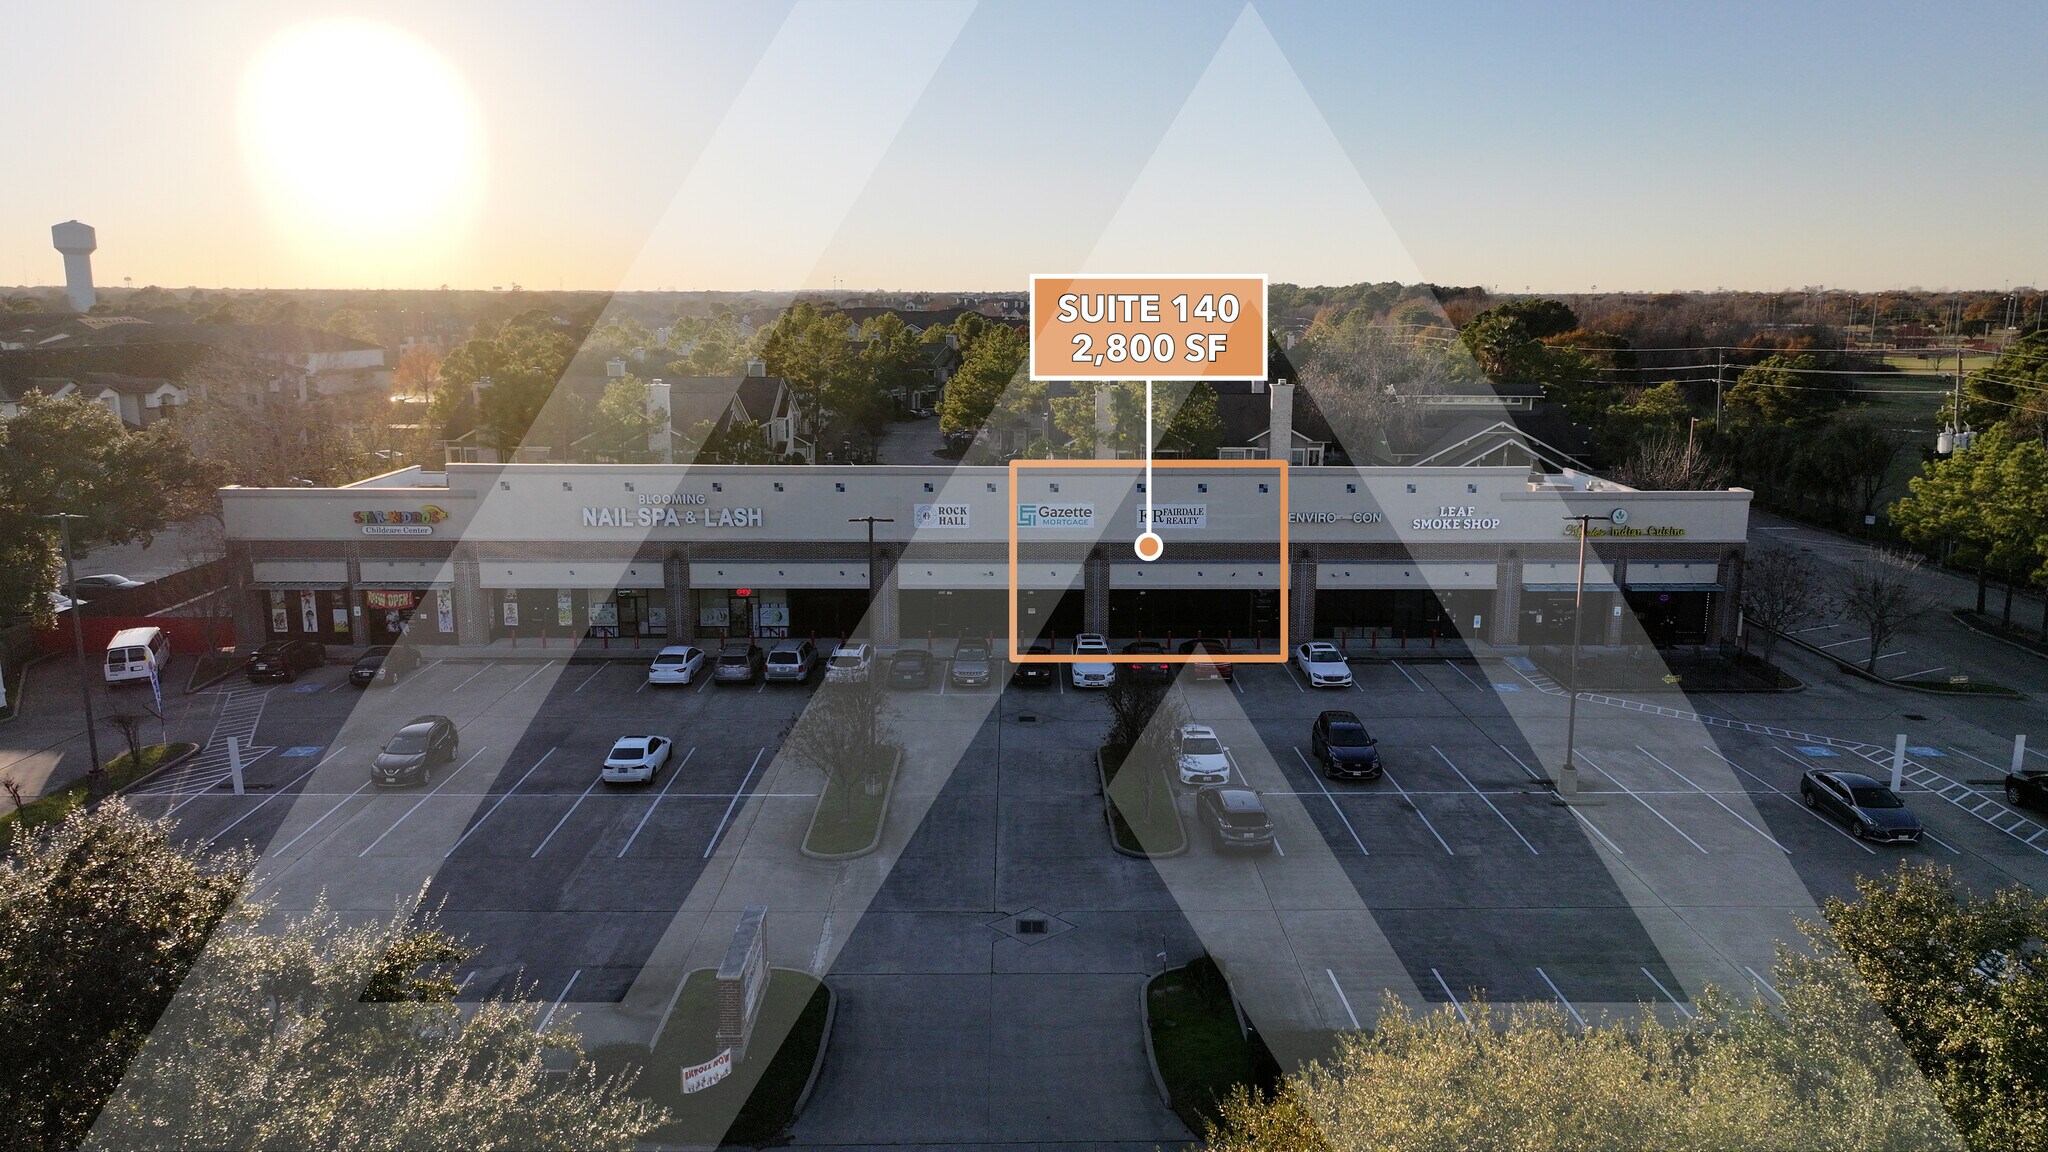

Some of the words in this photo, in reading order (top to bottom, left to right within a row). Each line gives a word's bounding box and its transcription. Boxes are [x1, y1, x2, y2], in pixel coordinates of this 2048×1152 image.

[638, 494, 706, 505] BLOOMING
[938, 506, 967, 516] ROCK
[1038, 506, 1092, 518] Gazette
[1163, 508, 1204, 516] FAIRDALE
[1439, 506, 1475, 517] LEAF
[582, 507, 634, 527] NAIL
[637, 507, 680, 527] SPA
[685, 511, 697, 524] &
[704, 507, 763, 527] LASH
[939, 516, 967, 526] HALL
[1166, 516, 1199, 525] REALTY
[1288, 512, 1336, 523] ENVIRO
[1353, 512, 1382, 523] CON
[365, 526, 402, 534] Childcare
[403, 526, 429, 534] Center
[1412, 519, 1460, 530] SMOKE
[1463, 519, 1500, 530] SHOP
[1610, 525, 1642, 536] Indian
[1647, 525, 1685, 536] Cuisine
